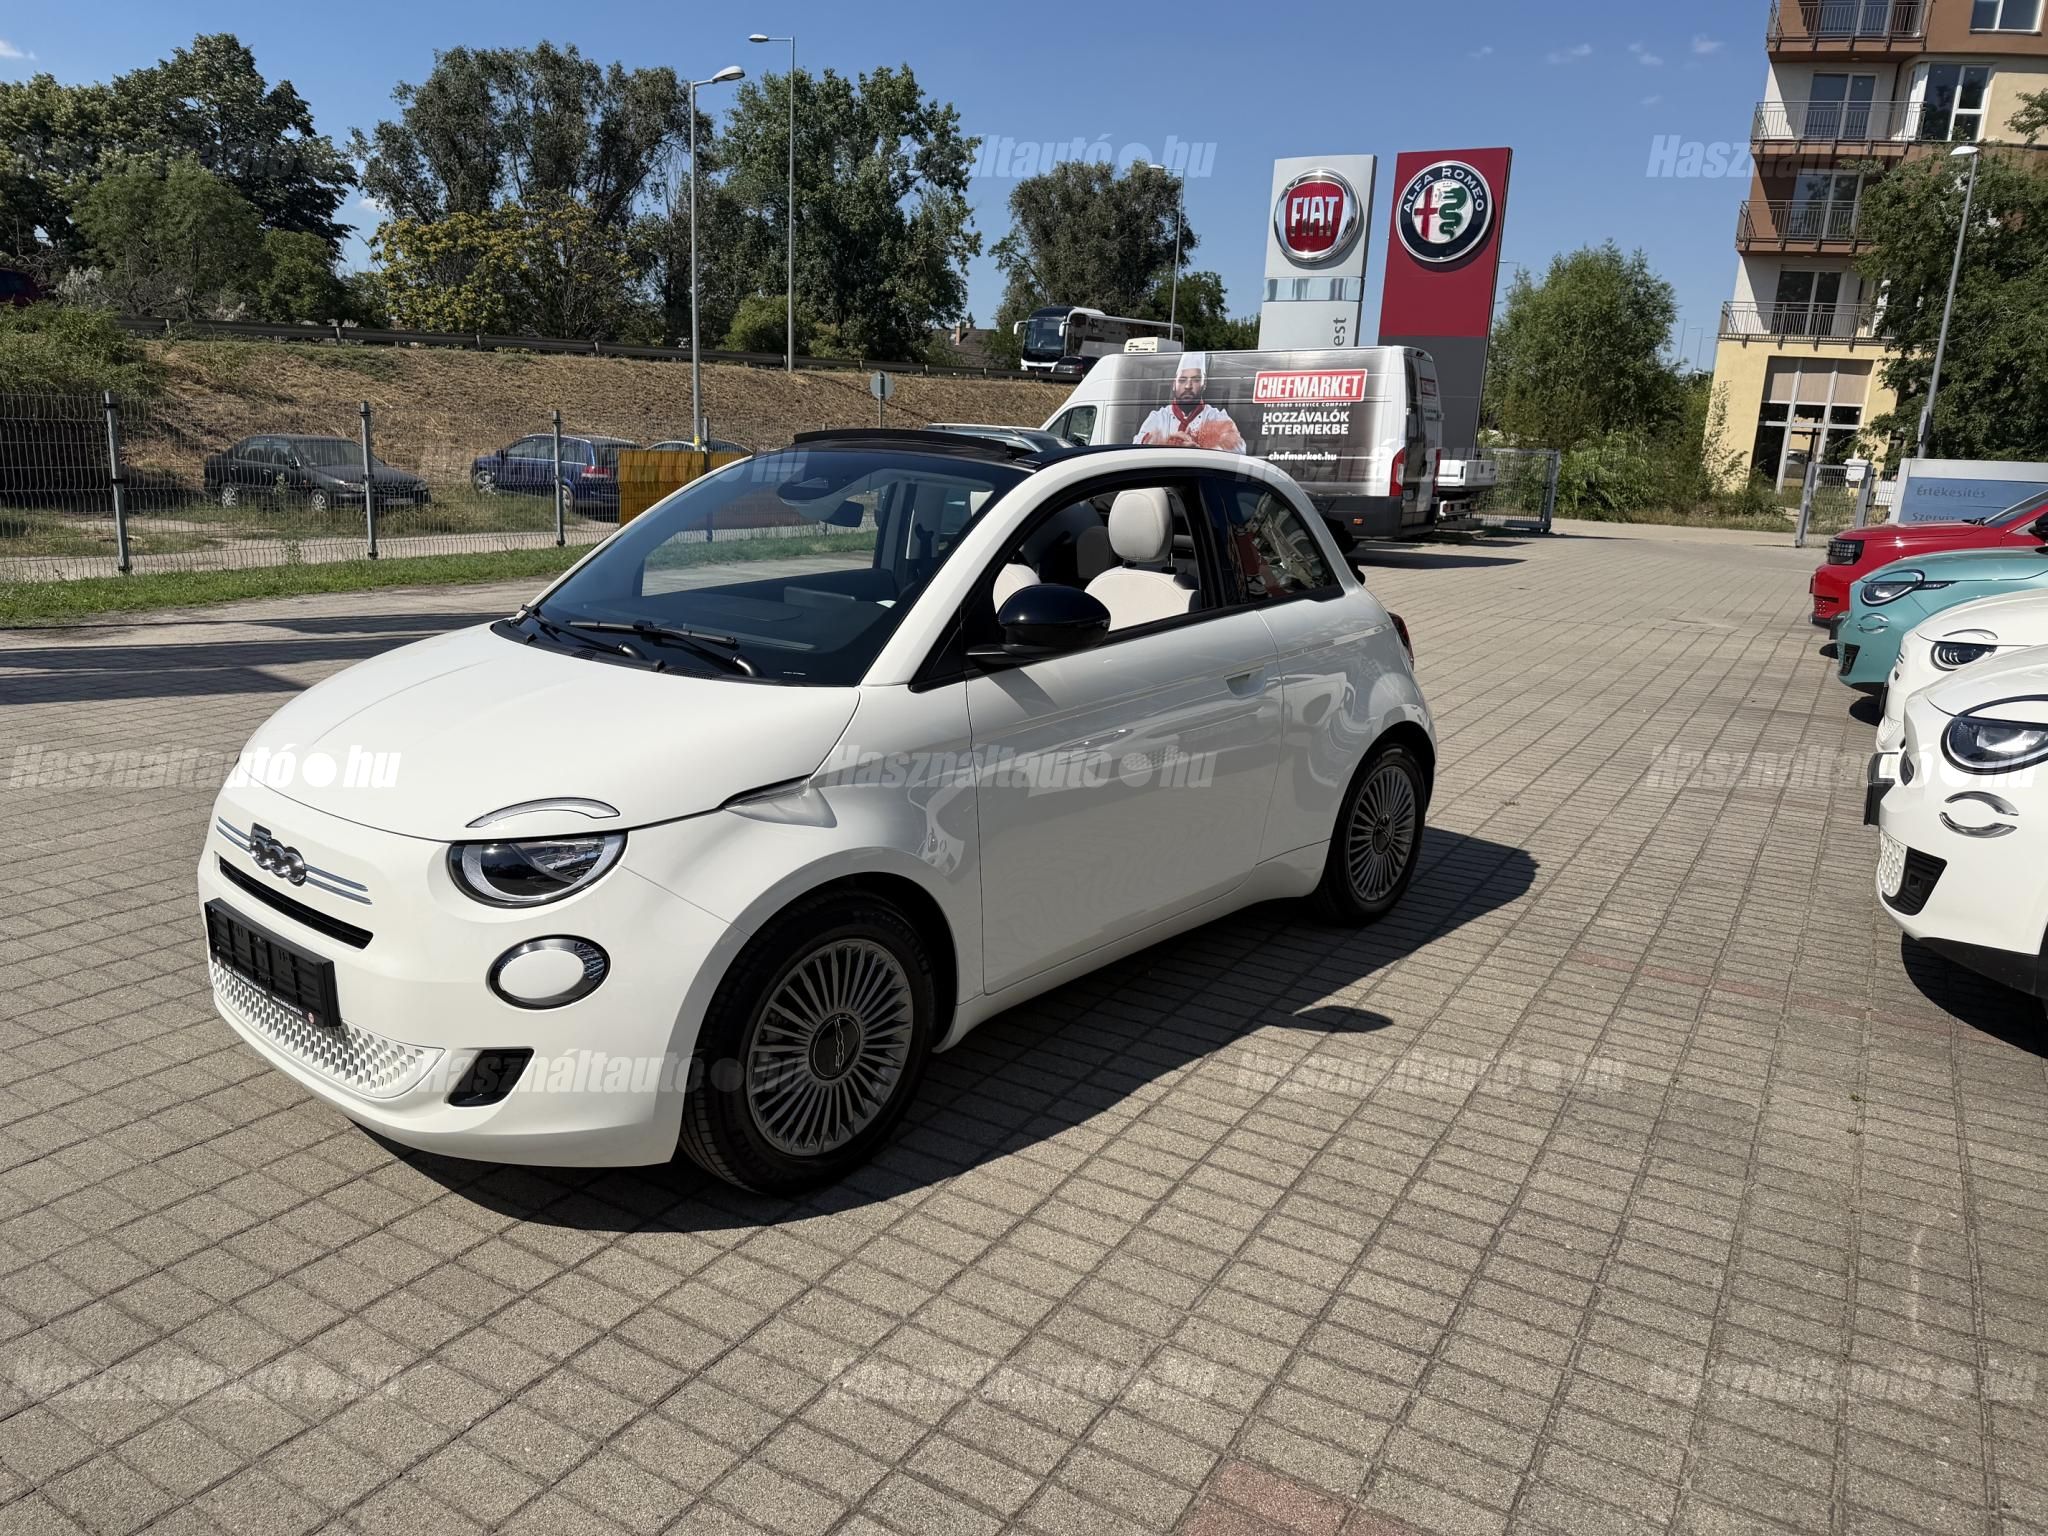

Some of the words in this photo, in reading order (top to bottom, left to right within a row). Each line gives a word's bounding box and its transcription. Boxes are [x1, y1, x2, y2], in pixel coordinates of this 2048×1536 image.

[1403, 173, 1437, 213] ALFA
[1441, 167, 1485, 212] ROMEO
[1290, 195, 1340, 238] FIAT
[1332, 316, 1348, 347] est
[1256, 374, 1363, 399] CHEFMARKET
[1262, 408, 1350, 423] HOZZÁVALÓK
[1261, 422, 1349, 435] ÉTTERMEKBE
[1268, 451, 1337, 461] chefmarket.hu
[1916, 486, 1986, 499] Értékesítés
